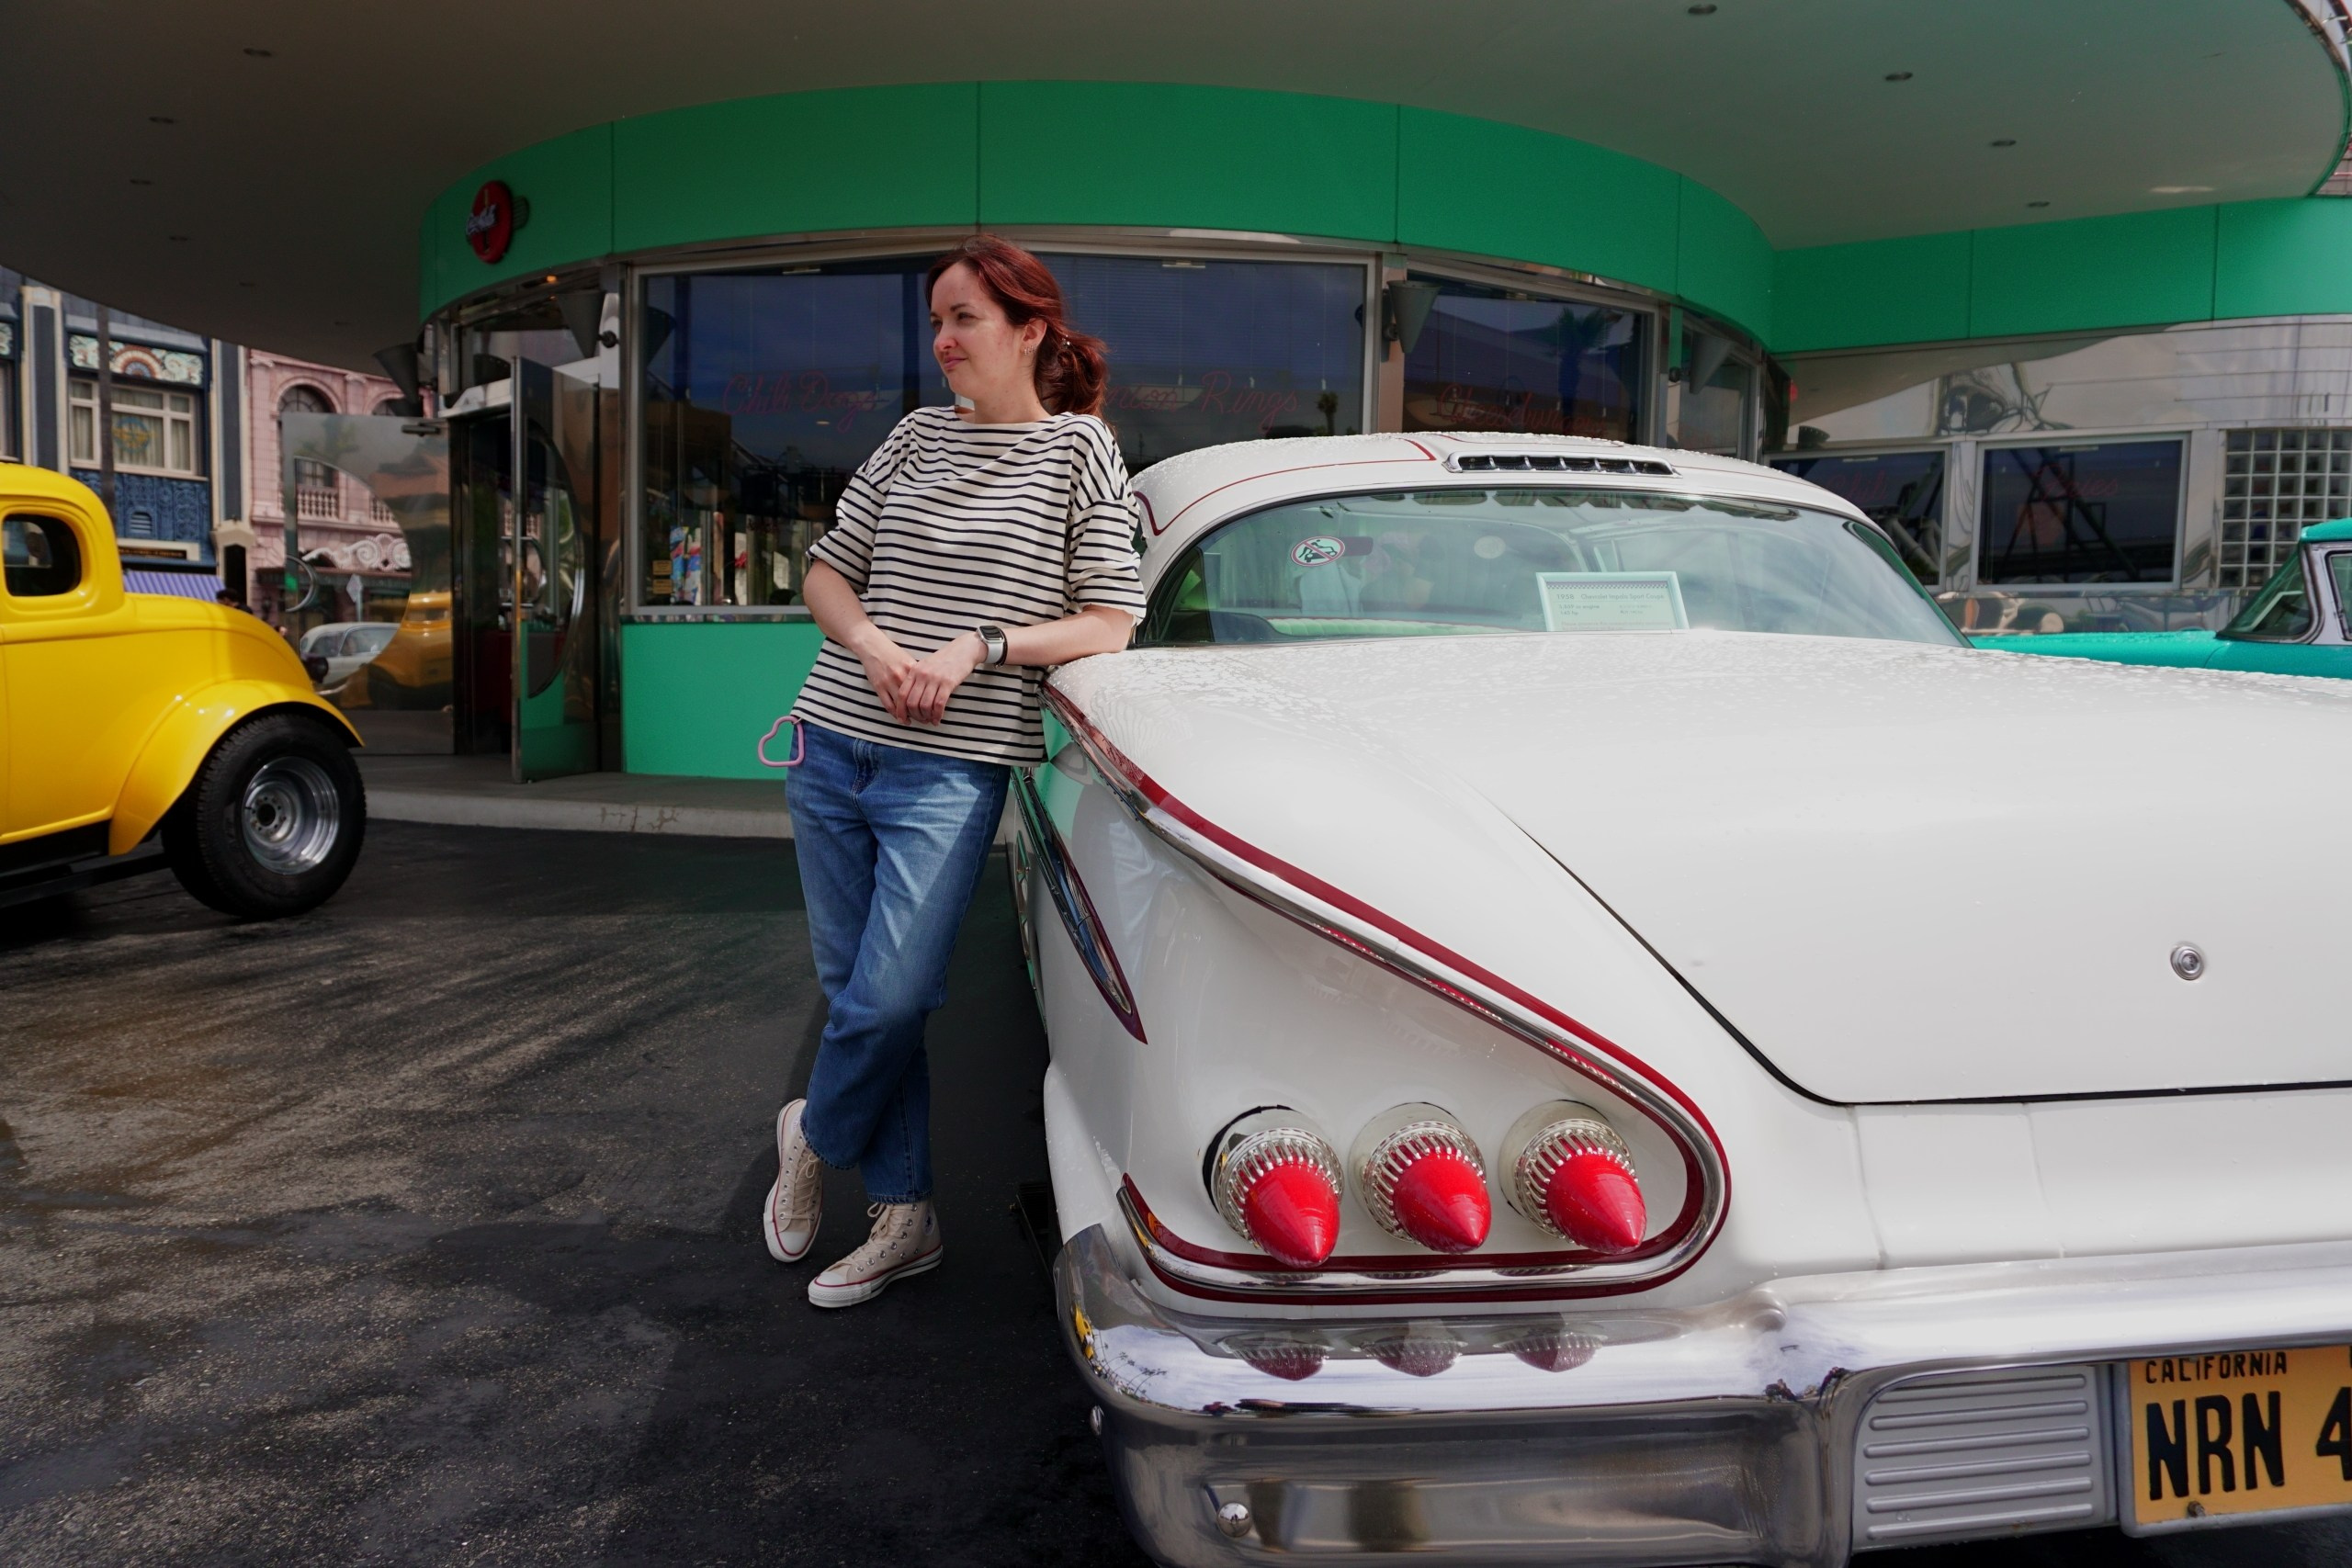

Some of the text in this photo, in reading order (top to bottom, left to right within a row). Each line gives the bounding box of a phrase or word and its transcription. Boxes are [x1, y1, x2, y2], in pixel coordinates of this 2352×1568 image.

[722, 369, 878, 434] Chili Dogs
[1104, 369, 1299, 434] nion Rings
[1609, 593, 1628, 602] Impala
[1629, 592, 1645, 601] Sport
[2145, 1352, 2288, 1383] CALIFORNIA
[2146, 1387, 2352, 1500] NRN 4
